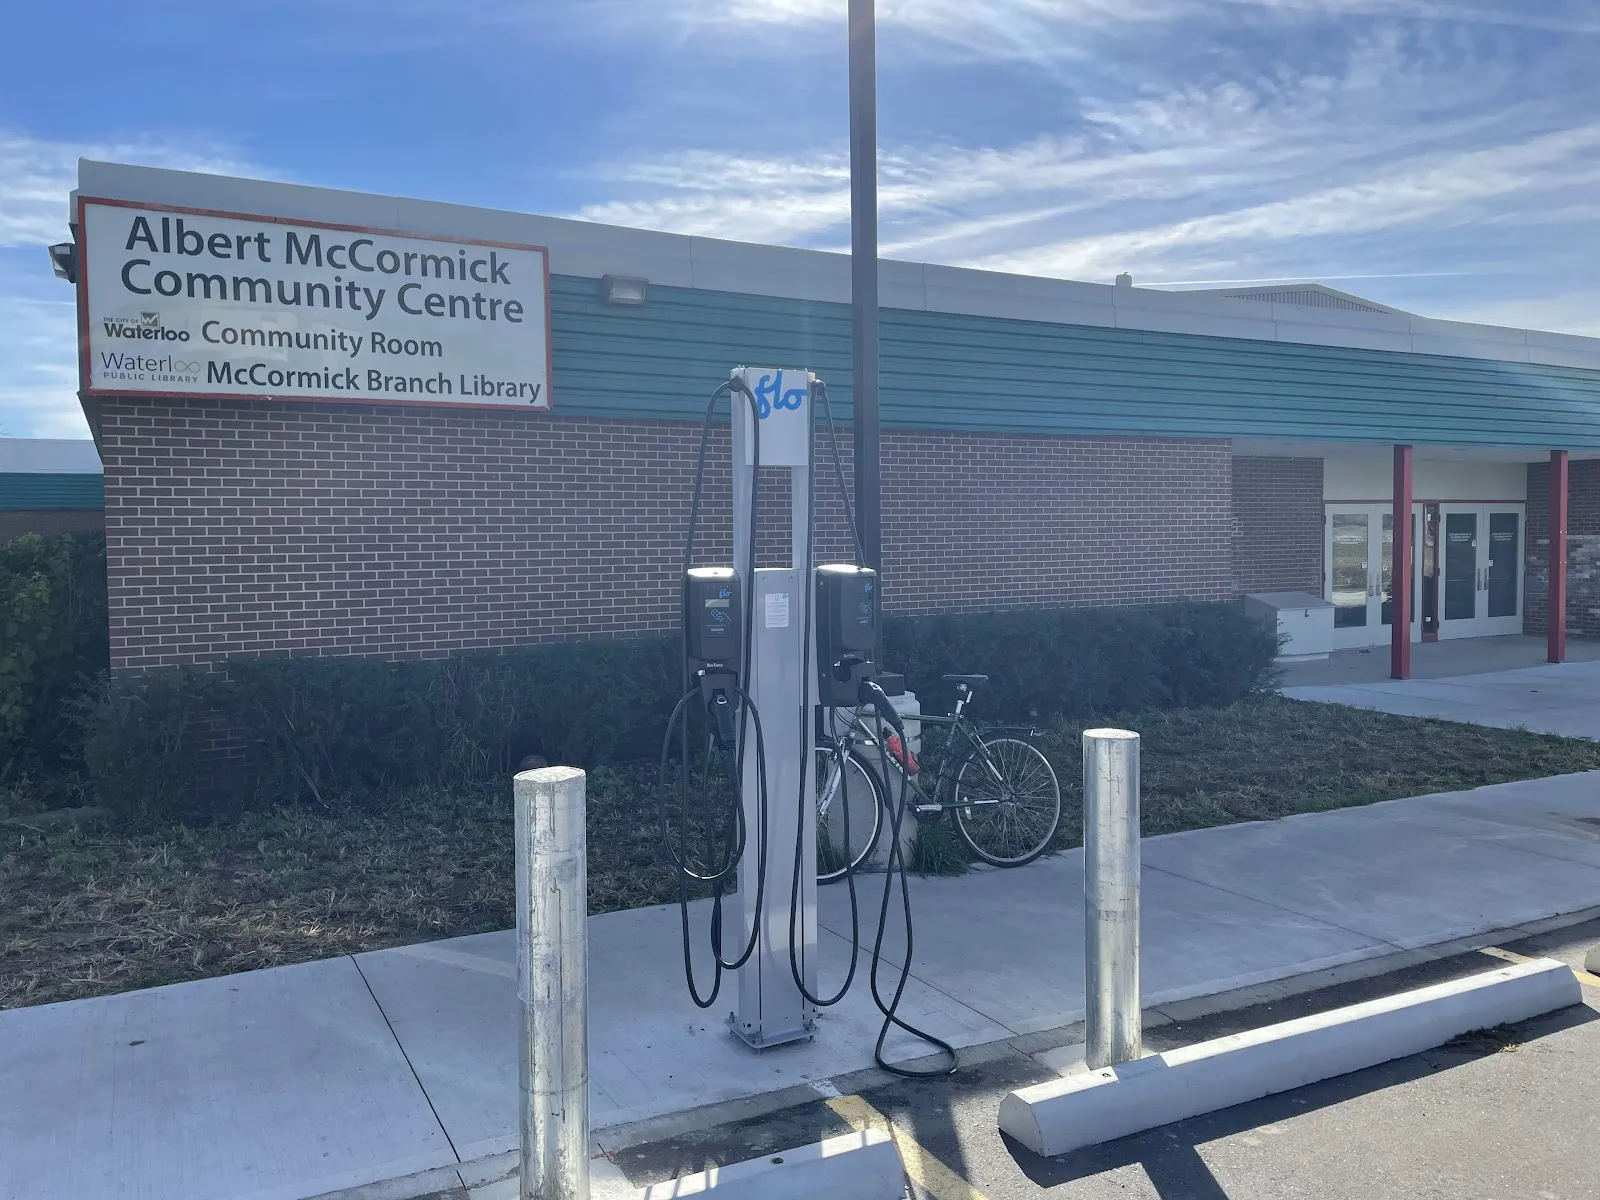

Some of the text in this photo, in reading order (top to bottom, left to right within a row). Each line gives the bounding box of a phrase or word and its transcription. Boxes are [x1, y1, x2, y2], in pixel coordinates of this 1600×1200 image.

[125, 216, 511, 285] Albert McCormick
[121, 259, 524, 323] Community Centre
[103, 323, 190, 341] Waterloo
[202, 320, 443, 358] Community Room
[103, 371, 198, 383] PUBLIC LIBRARY
[207, 361, 541, 404] McCormick Branch Library
[754, 370, 808, 420] flo
